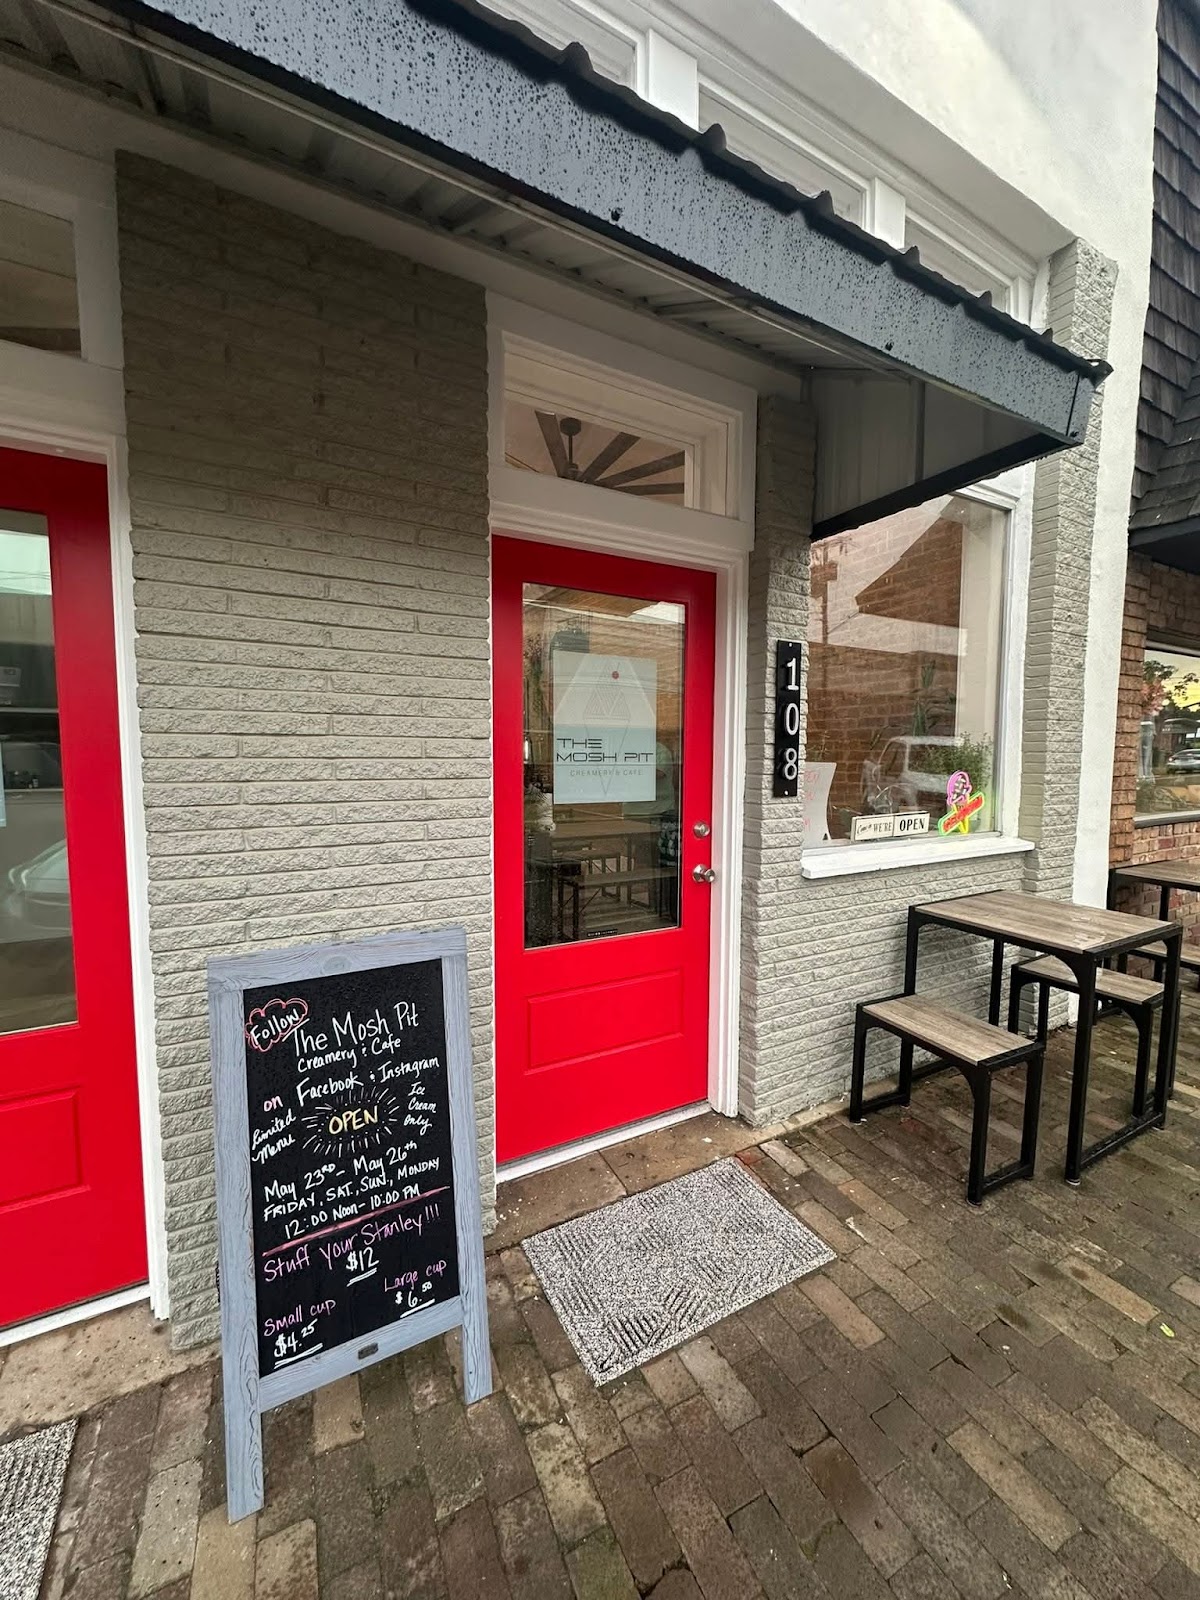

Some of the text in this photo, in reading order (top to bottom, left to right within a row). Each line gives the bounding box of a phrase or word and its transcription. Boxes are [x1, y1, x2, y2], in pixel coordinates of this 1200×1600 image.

[784, 657, 800, 781] 108
[556, 738, 602, 749] THE
[556, 752, 653, 762] MOSH PIT
[900, 819, 925, 832] OPEN
[250, 1008, 300, 1046] Follow
[282, 1001, 419, 1057] The Mosh Pit
[298, 1048, 357, 1073] Creamery
[371, 1034, 401, 1055] Cafe
[263, 1095, 283, 1112] on
[296, 1071, 364, 1107] Facebook
[378, 1057, 439, 1083] Instagram
[408, 1082, 425, 1096] Ice
[329, 1105, 378, 1134] OPEN
[408, 1097, 436, 1113] Cream
[264, 1179, 297, 1202] May
[353, 1154, 386, 1176] May
[385, 1140, 417, 1165] 26th
[398, 1157, 440, 1180] MONDAY
[285, 1211, 328, 1239] 12:00
[370, 1190, 400, 1210] 10:00
[402, 1183, 420, 1200] PM
[264, 1244, 310, 1282] Stuff
[345, 1247, 380, 1271] $12
[385, 1259, 447, 1294] Large cup
[264, 1300, 336, 1336] Small cup
